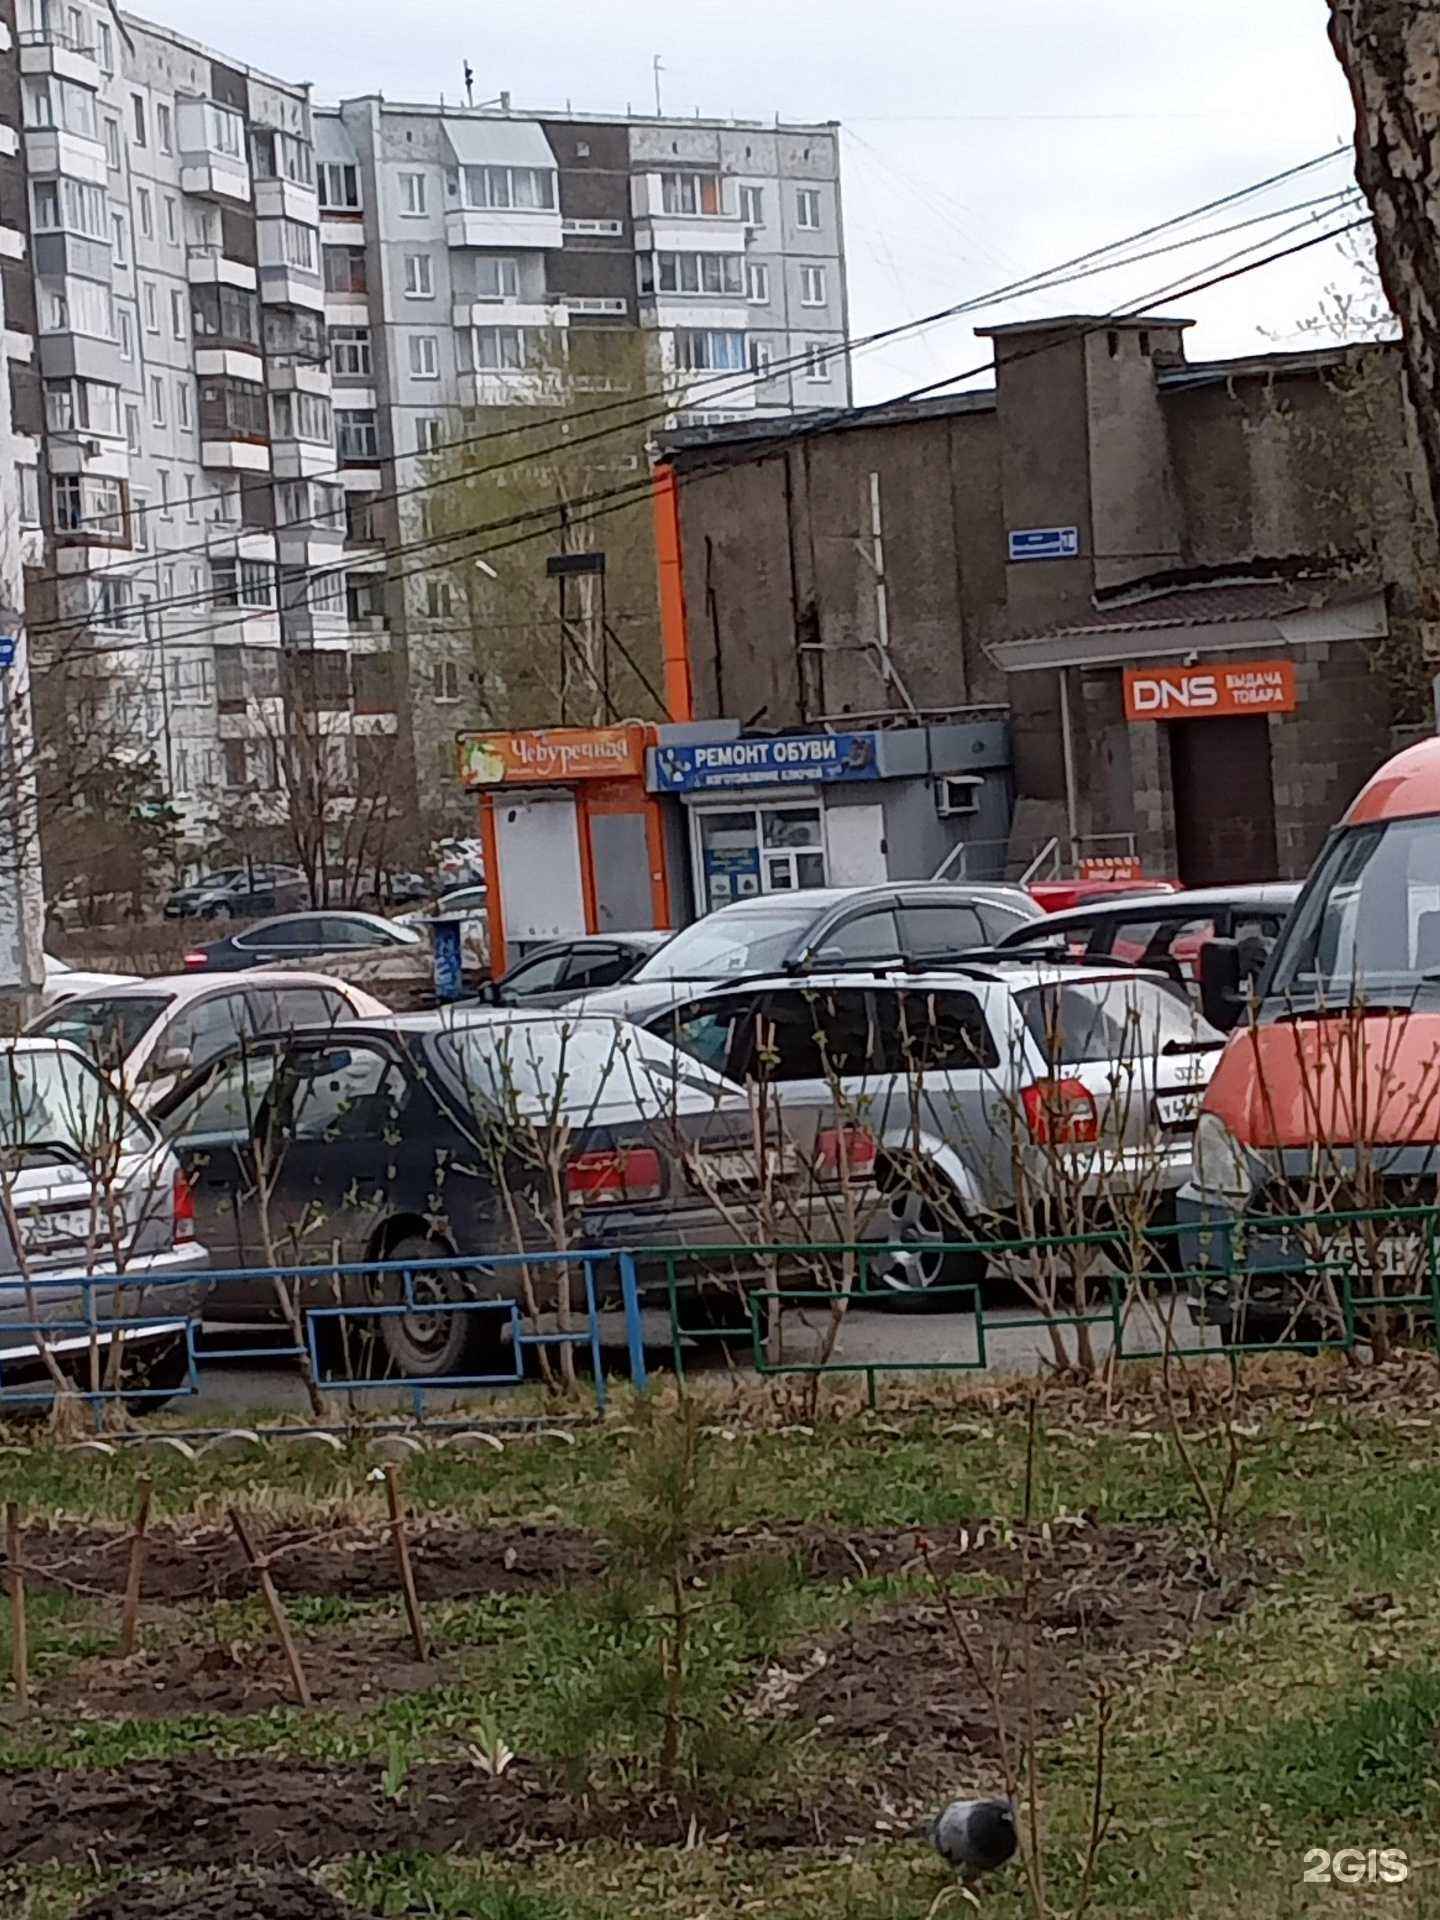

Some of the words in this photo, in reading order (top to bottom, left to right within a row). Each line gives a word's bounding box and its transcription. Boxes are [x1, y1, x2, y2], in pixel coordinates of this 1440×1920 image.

[1133, 675, 1218, 710] DNS
[1226, 671, 1283, 688] ВЫДАЧА
[1232, 687, 1284, 704] ТОВАРА
[511, 738, 629, 775] Чебуречная
[694, 743, 769, 768] РЕМОНТ
[773, 739, 836, 762] ОБУВИ
